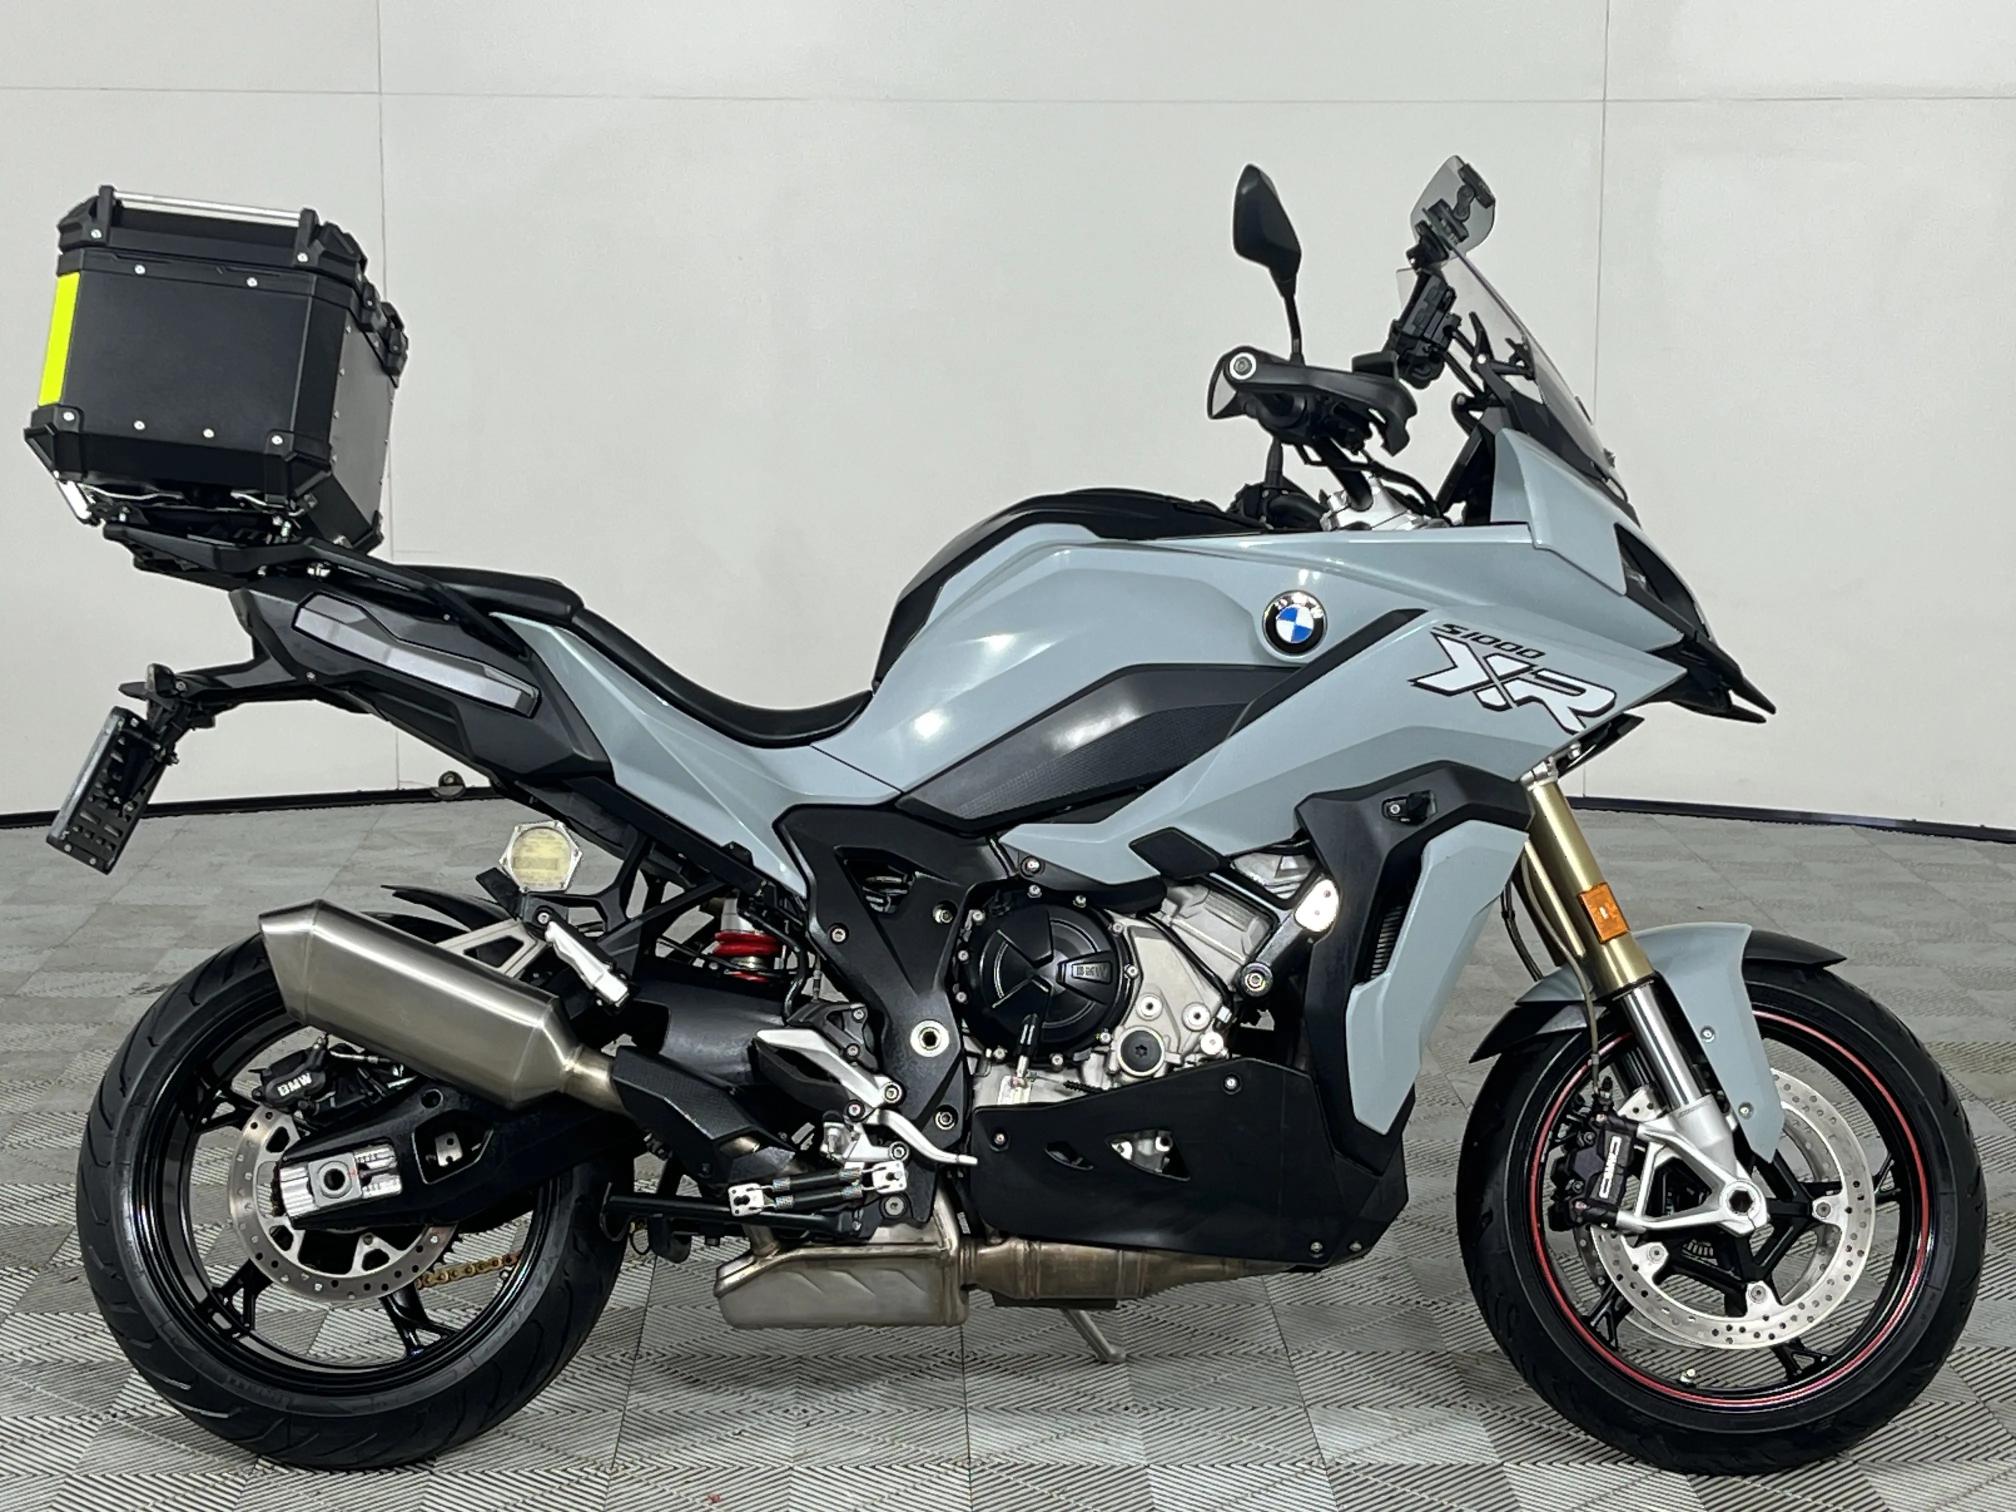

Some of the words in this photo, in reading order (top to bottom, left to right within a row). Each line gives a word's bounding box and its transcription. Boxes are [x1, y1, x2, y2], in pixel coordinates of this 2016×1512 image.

[1432, 623, 1546, 660] S1000
[1408, 631, 1617, 736] XR
[277, 1072, 312, 1097] BMW
